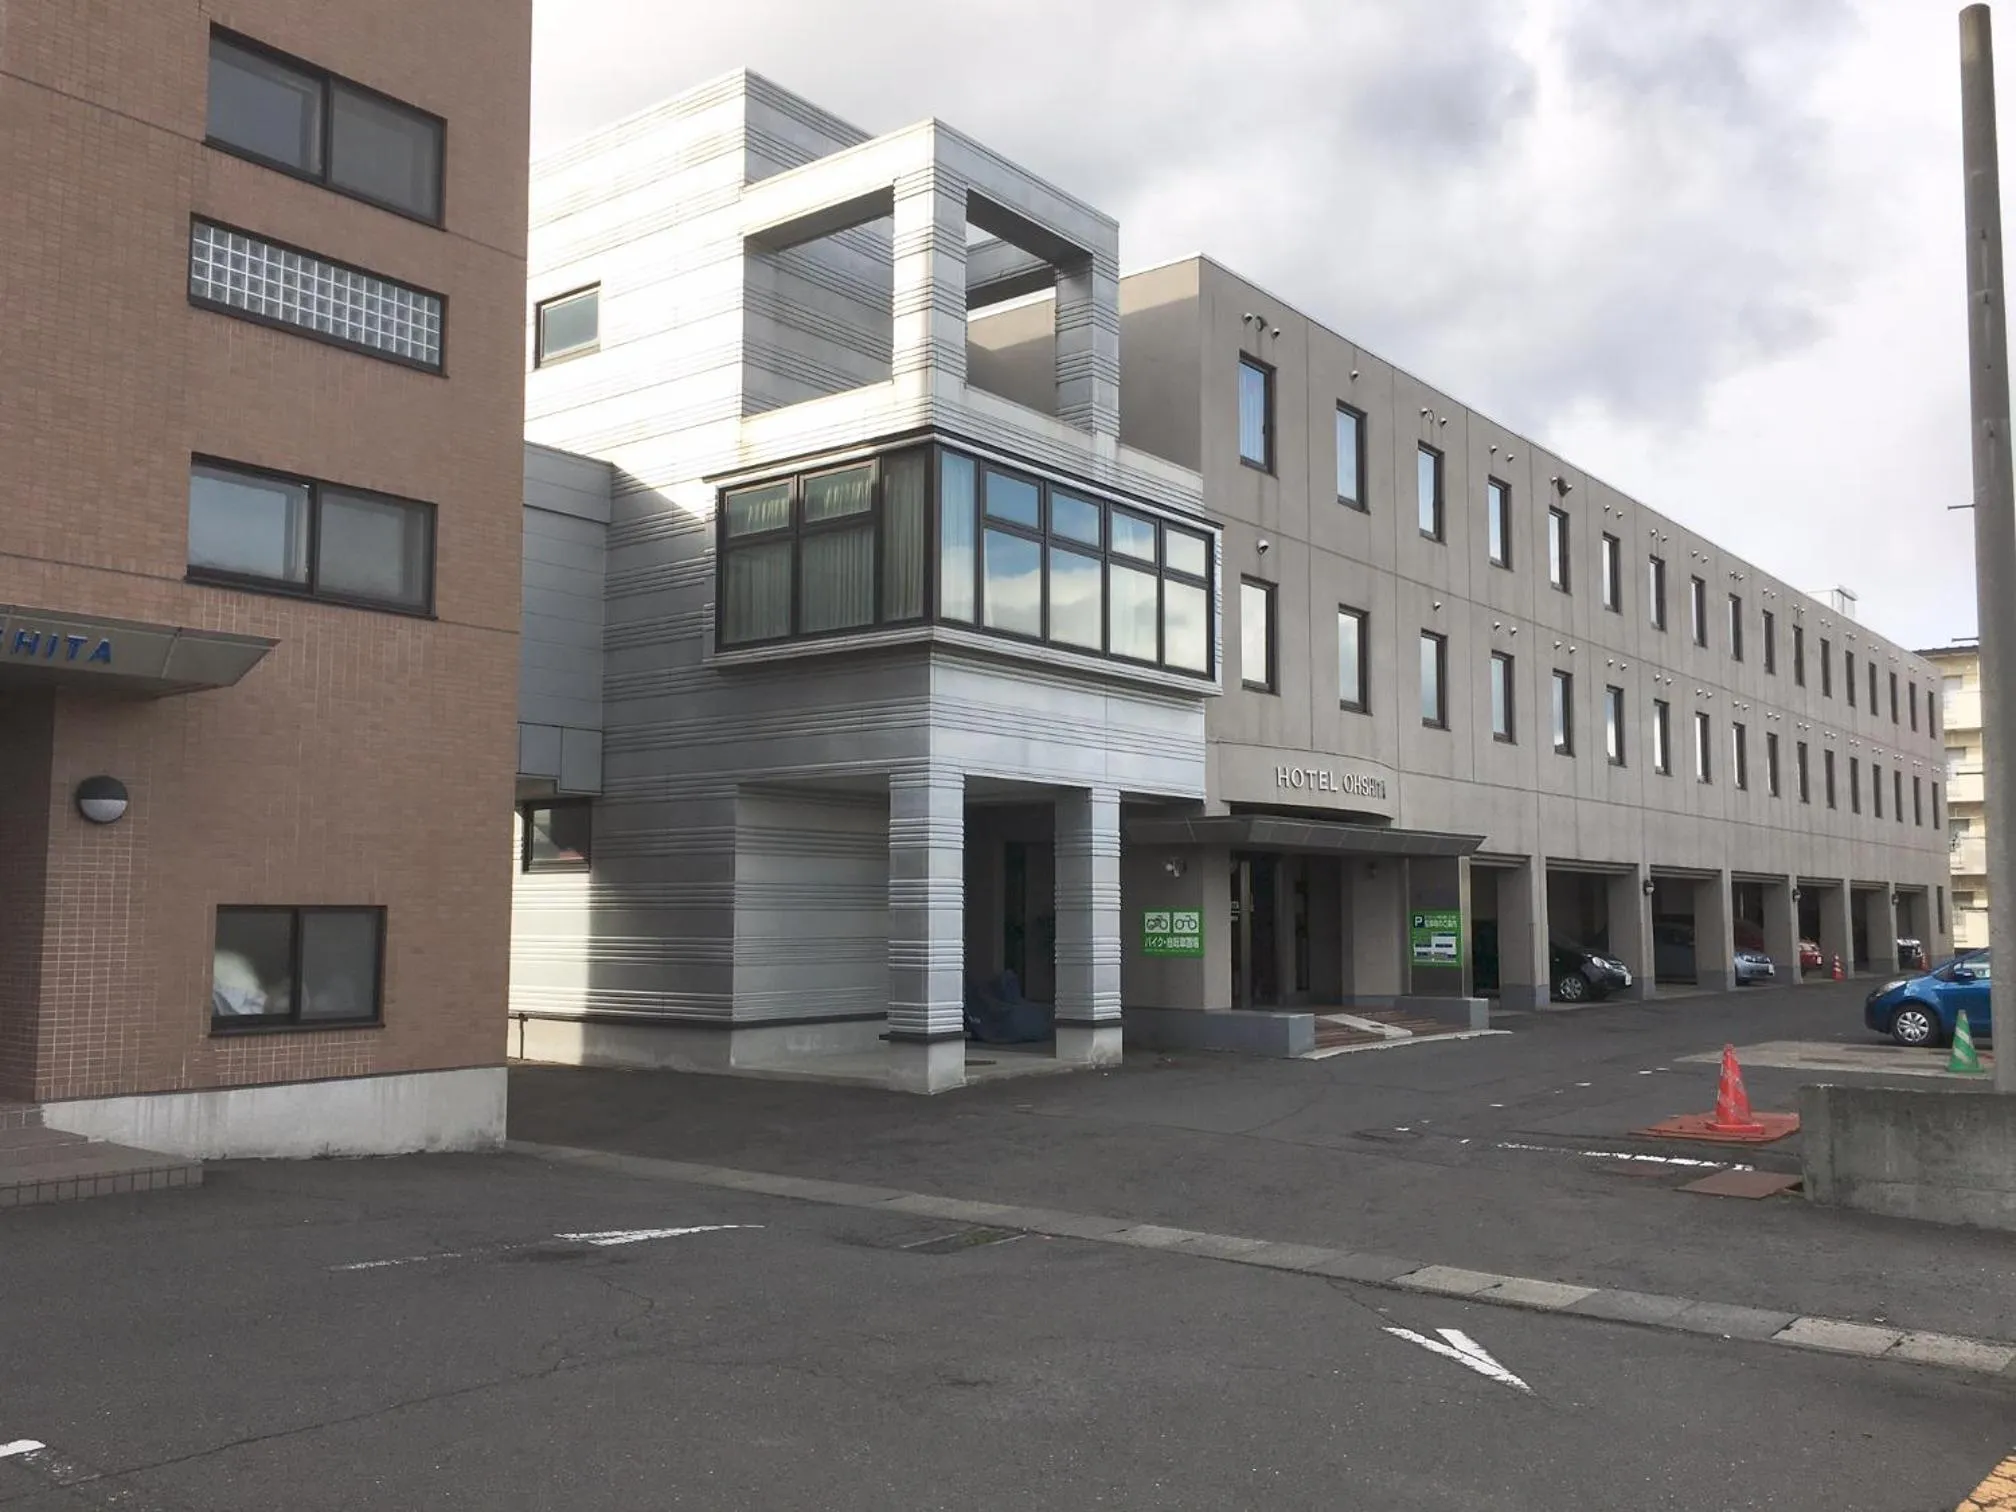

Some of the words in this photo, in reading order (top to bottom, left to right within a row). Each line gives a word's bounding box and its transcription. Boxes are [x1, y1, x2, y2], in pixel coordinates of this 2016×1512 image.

[0, 628, 111, 664] HITA
[1276, 766, 1338, 792] HOTEL
[1415, 916, 1423, 927] P
